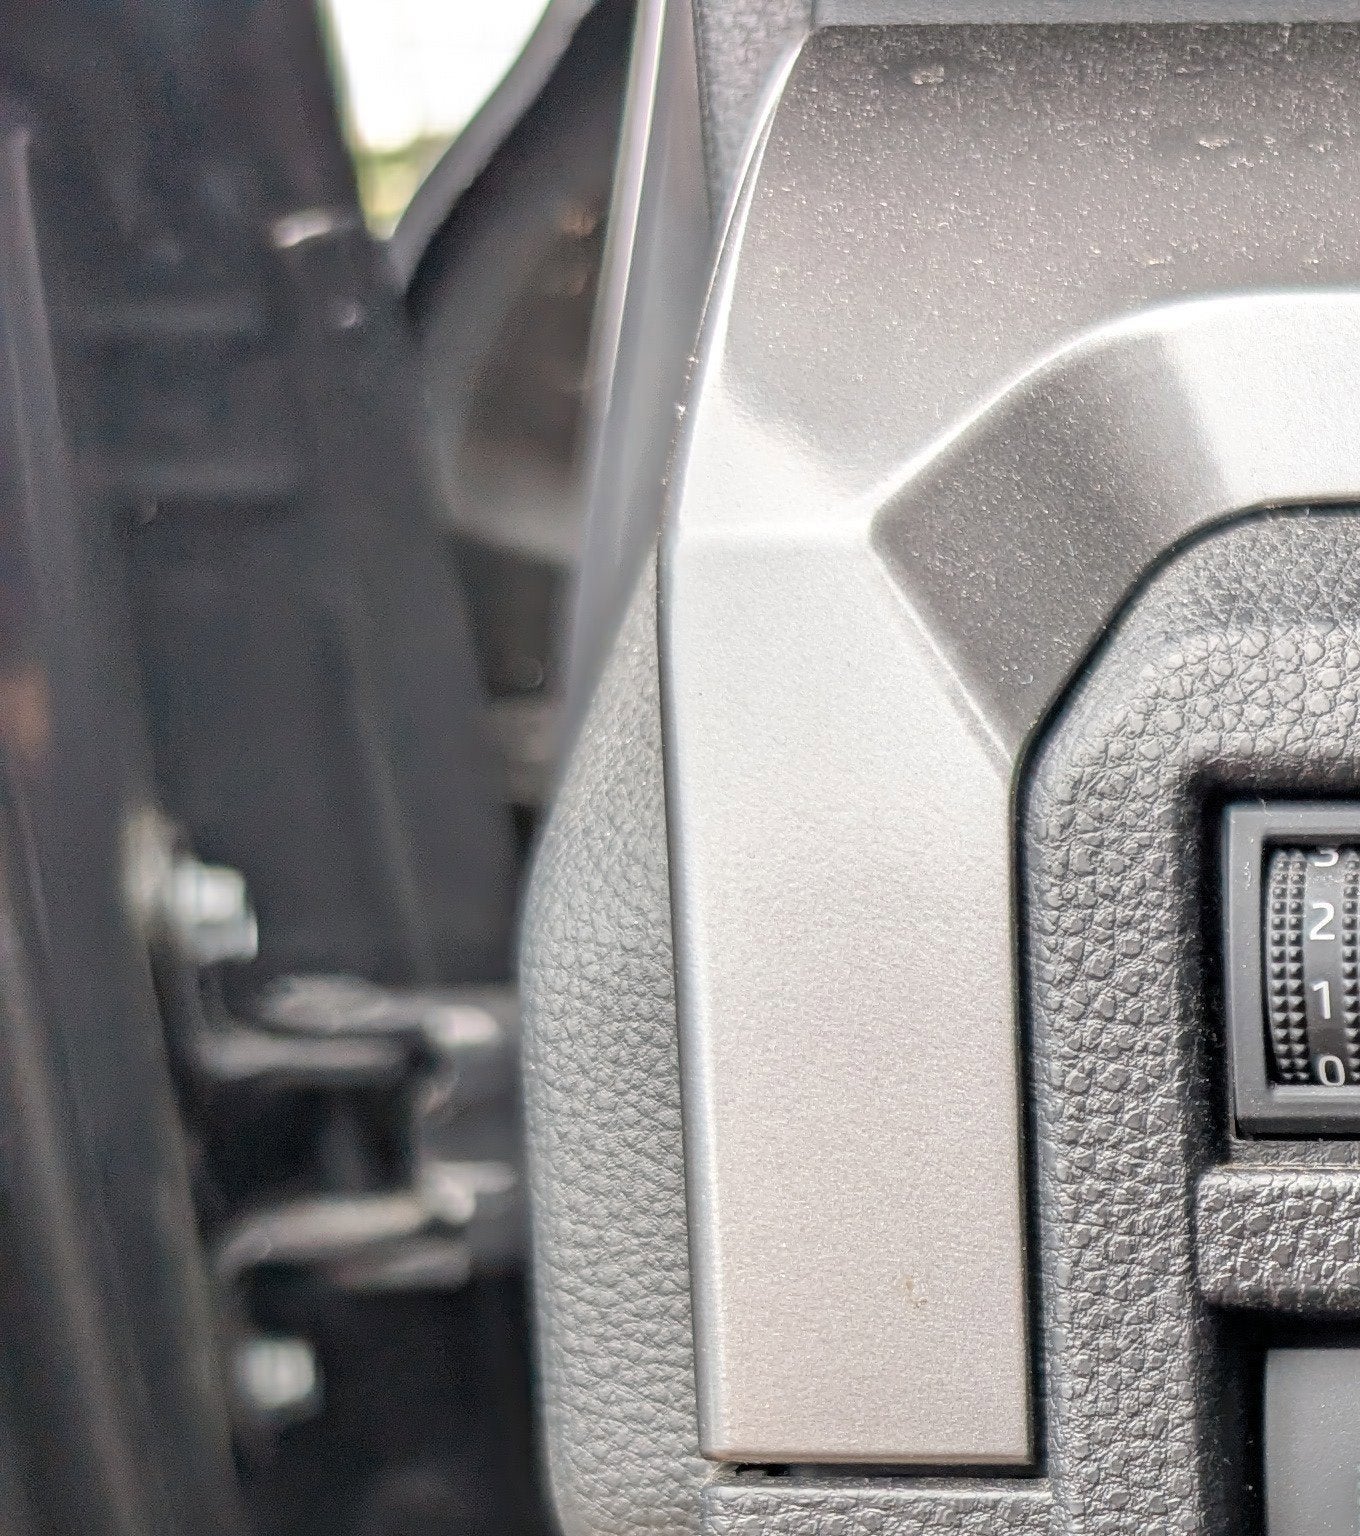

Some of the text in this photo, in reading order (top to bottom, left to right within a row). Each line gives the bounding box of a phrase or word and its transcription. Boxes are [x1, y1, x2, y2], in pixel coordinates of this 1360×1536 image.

[1309, 902, 1336, 941] 2
[1312, 980, 1331, 1020] 1
[1317, 1055, 1346, 1087] 0
